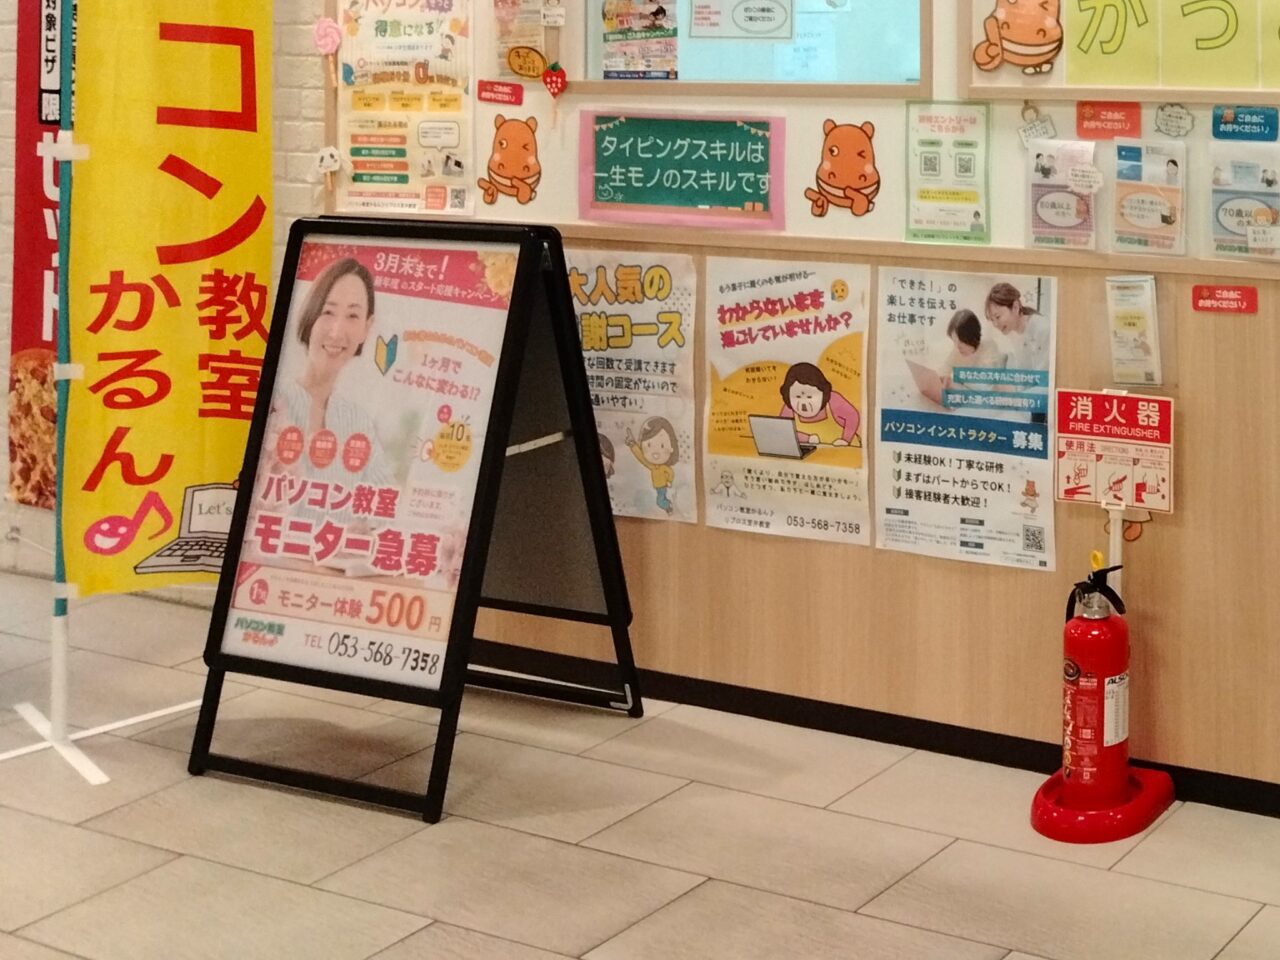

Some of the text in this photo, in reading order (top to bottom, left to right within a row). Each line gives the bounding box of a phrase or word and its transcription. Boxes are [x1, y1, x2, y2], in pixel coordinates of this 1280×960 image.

[601, 135, 765, 164] タイピングスキルは
[593, 164, 772, 195] 一生モノのスキルです
[568, 263, 672, 306] 大人気の
[717, 288, 825, 326] わからないまま
[887, 293, 957, 312] 楽しさを伝える
[575, 310, 686, 352] 謝コース
[887, 311, 937, 328] お仕事です
[82, 270, 182, 492] かるん
[1068, 395, 1161, 428] 消火器
[884, 421, 1044, 451] パソコンインストラクター 募集
[1065, 439, 1097, 454] 使用法
[1069, 423, 1161, 440] FIRE EXTINGUISHER
[261, 474, 400, 520] パソコン教室
[786, 514, 861, 535] 053-568-7358
[255, 513, 441, 577] モニター急募
[304, 633, 323, 650] TEL
[327, 631, 441, 676] 053-568-7358
